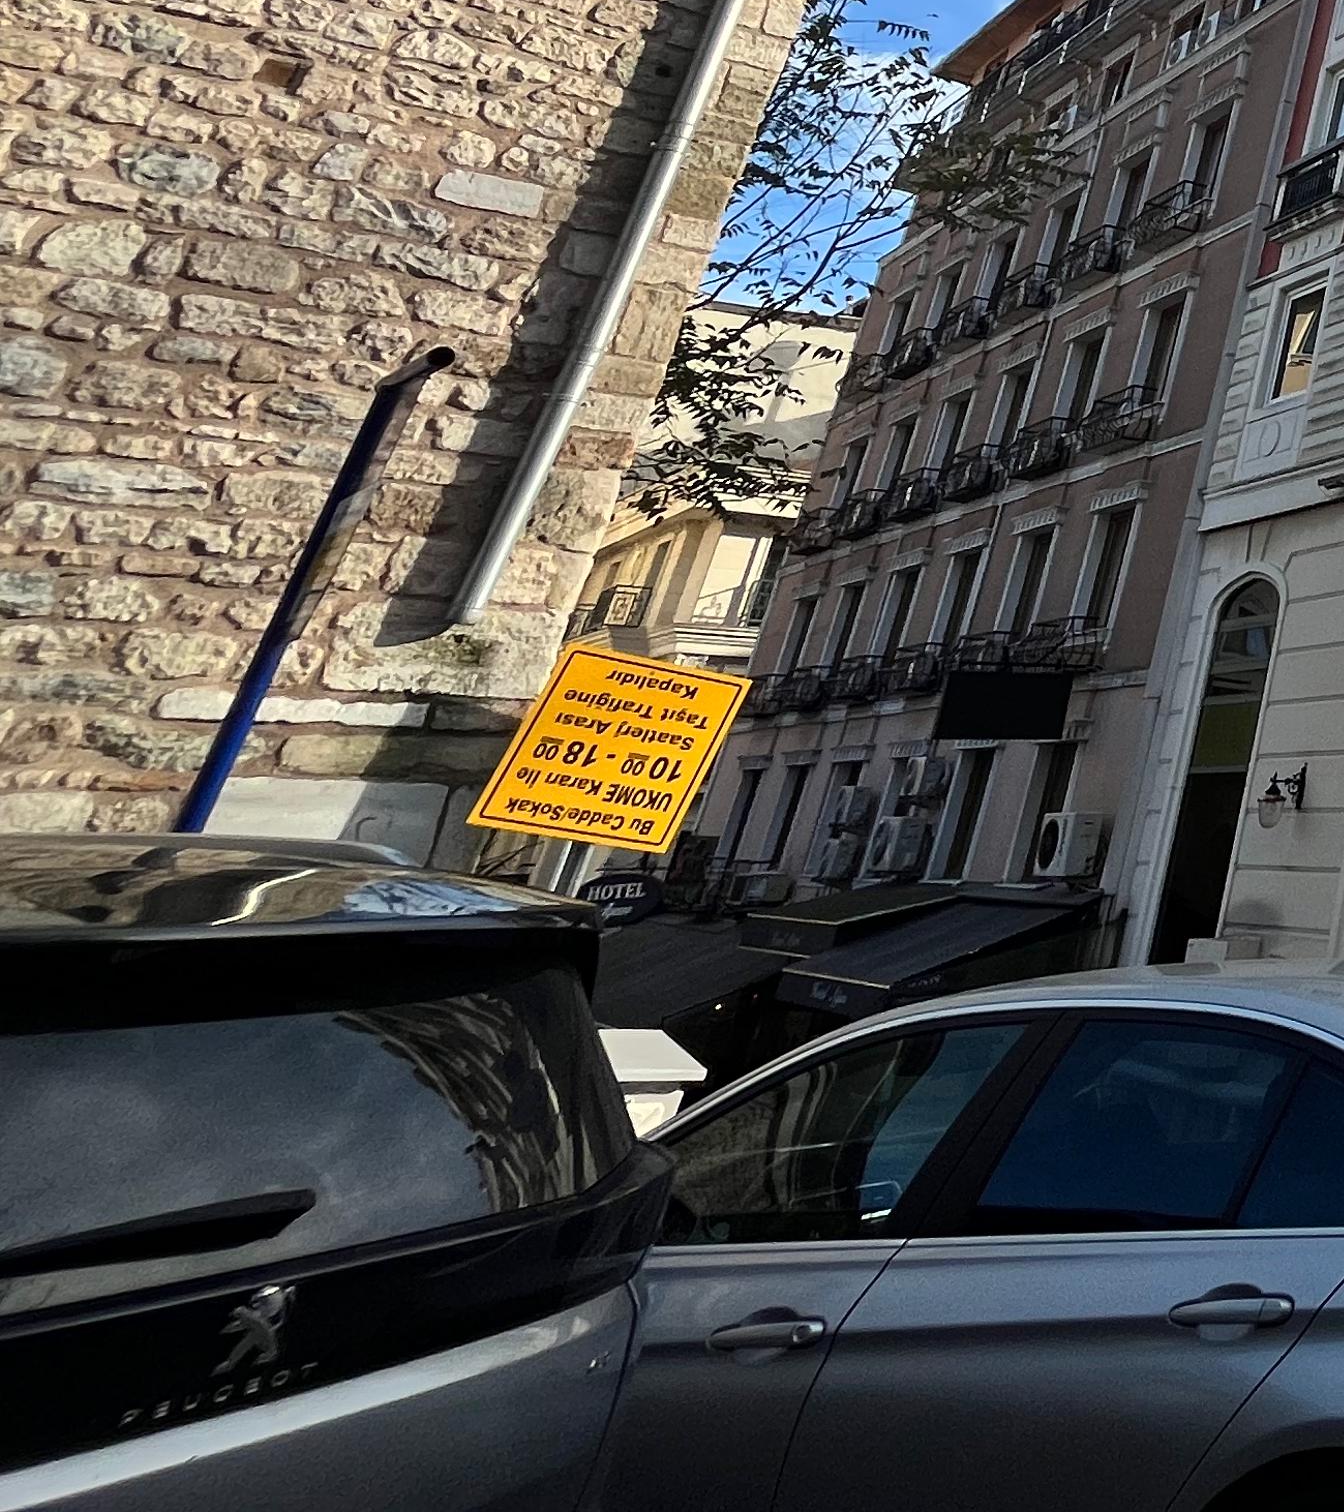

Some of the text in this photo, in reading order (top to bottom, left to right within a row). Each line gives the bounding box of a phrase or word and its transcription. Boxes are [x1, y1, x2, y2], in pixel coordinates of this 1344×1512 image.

[563, 740, 599, 768] 18
[649, 756, 684, 783] 10
[602, 784, 673, 813] UKOME
[504, 796, 655, 836] Bu Cadde/Sokak
[586, 882, 647, 902] HOTEL
[118, 1362, 318, 1428] PEUGEOT
